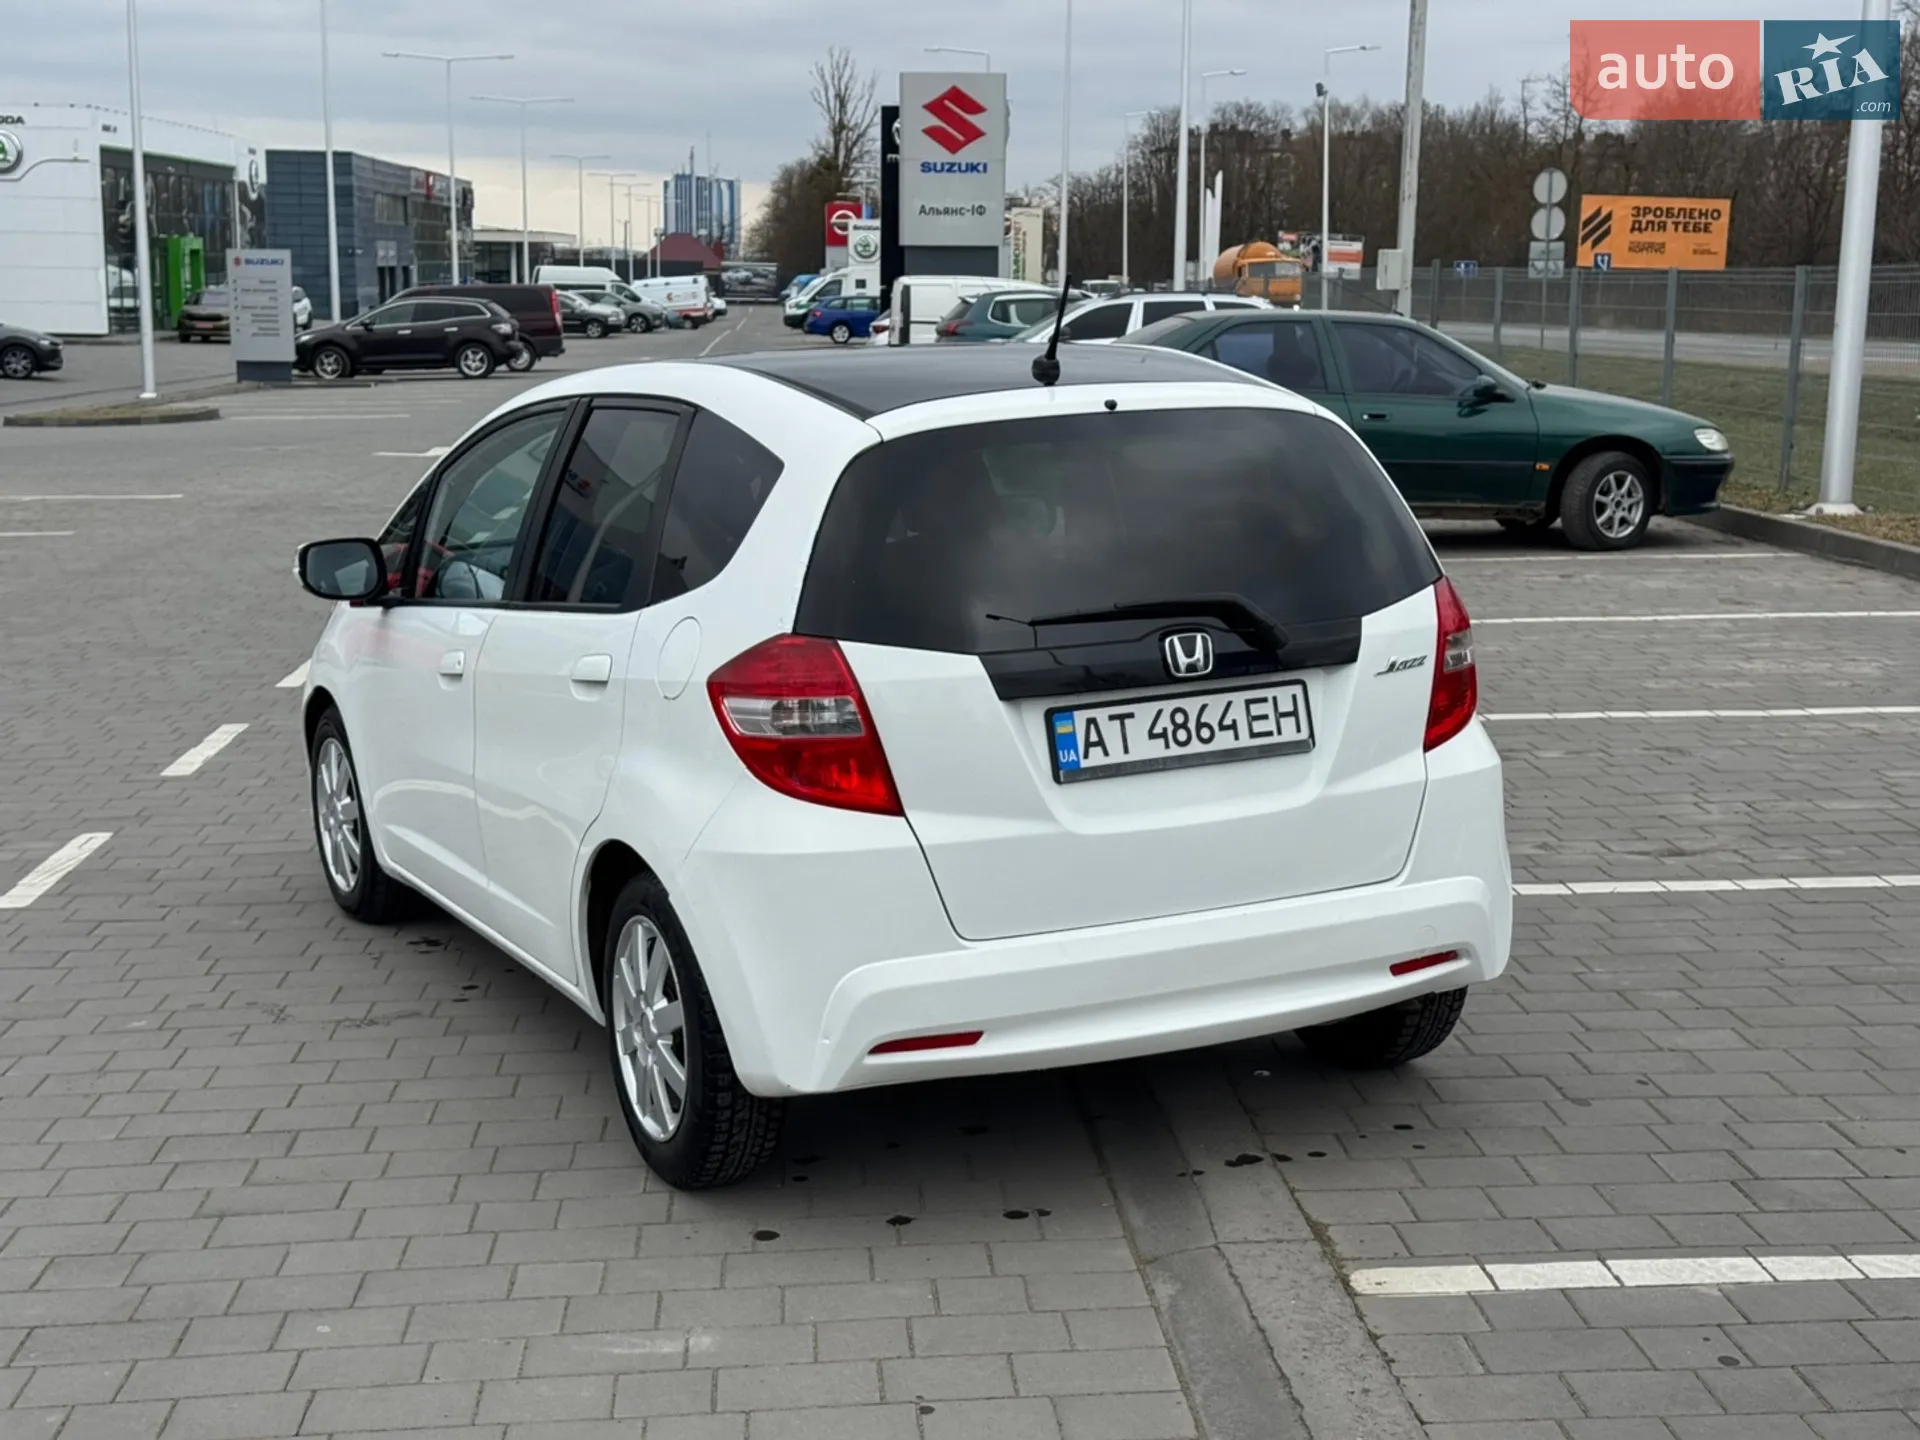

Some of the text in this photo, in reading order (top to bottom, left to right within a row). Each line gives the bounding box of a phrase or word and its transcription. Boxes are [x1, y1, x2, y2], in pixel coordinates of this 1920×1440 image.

[919, 161, 988, 174] SUZUKI
[918, 204, 987, 216] Альянс-ІФ
[1630, 206, 1722, 221] ЗРОБЛЕНО
[1630, 220, 1713, 234] ДЛЯ ТЕБЕ
[1083, 712, 1136, 760] AT
[1059, 749, 1078, 764] UA
